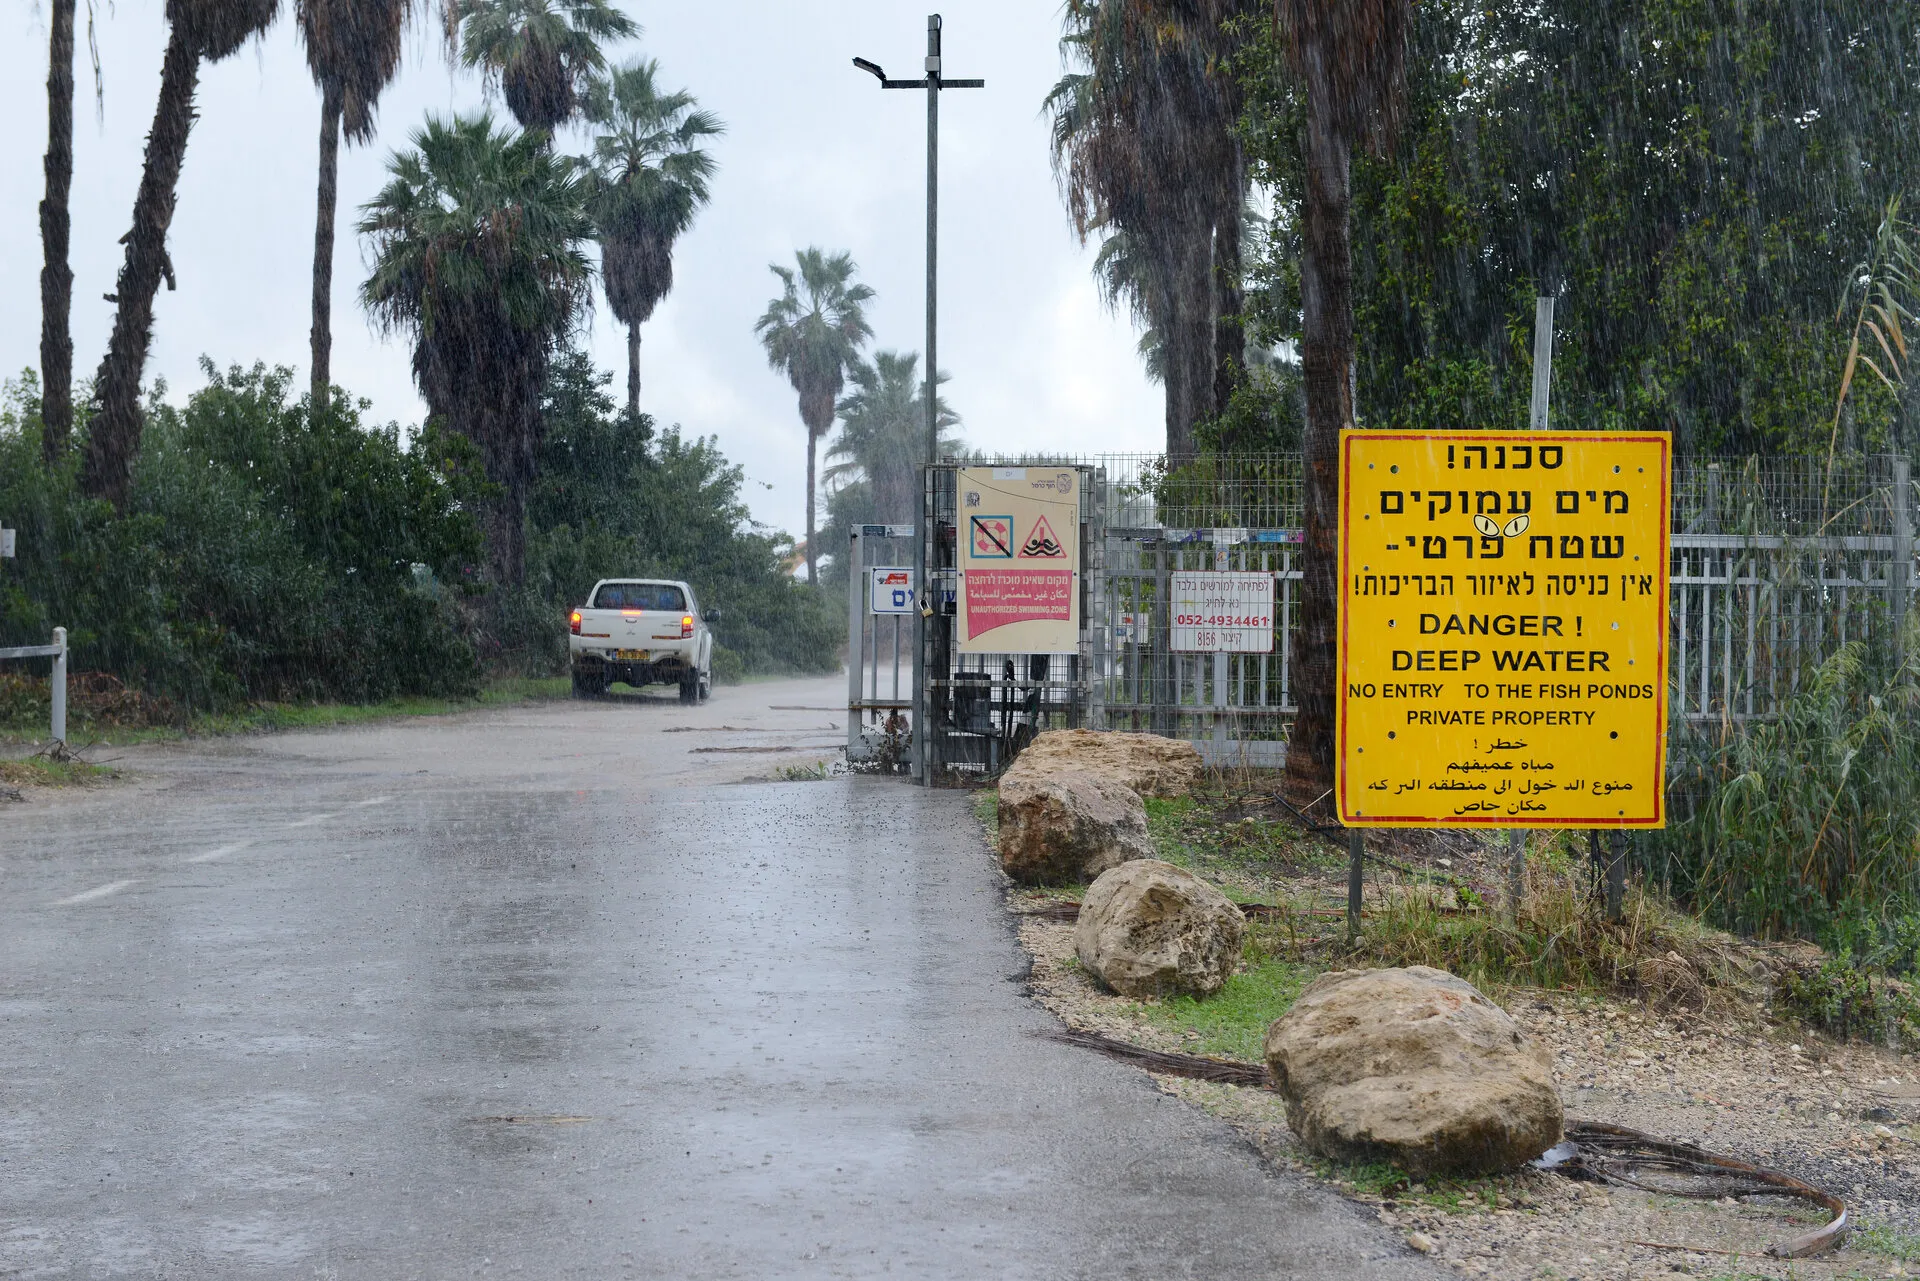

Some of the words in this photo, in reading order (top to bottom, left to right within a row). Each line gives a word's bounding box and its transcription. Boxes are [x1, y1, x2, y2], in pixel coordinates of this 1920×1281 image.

[1447, 444, 1564, 470] סכנה!
[1379, 490, 1532, 521] עמוקים
[1555, 489, 1629, 514] מים
[1528, 535, 1625, 559] שטח
[968, 573, 996, 585] לרחצה
[997, 575, 1021, 585] מוכרז
[1022, 575, 1045, 585] שאינו
[1047, 575, 1068, 587] מקום
[1176, 579, 1197, 591] בלבד
[1237, 579, 1269, 592] לפתיחה
[1354, 573, 1455, 597] הבריכות!
[1465, 570, 1535, 596] לאיזור
[1547, 574, 1609, 596] כניסה
[1033, 590, 1048, 600] غير
[1049, 589, 1068, 600] مكان
[1621, 574, 1653, 602] אין
[970, 605, 1018, 614] UNAUTHORIZED
[1018, 605, 1050, 614] SWIMMING
[1050, 605, 1068, 614] ZONE
[1177, 614, 1268, 627] 052-4934461
[1419, 613, 1564, 637] DANGER
[1576, 615, 1583, 637] !
[1197, 631, 1216, 647] 8156
[1392, 649, 1481, 672] DEEP
[1491, 650, 1611, 672] WATER
[1349, 683, 1377, 699] NO
[1382, 683, 1444, 698] ENTRY
[1463, 683, 1490, 699] TO
[1495, 683, 1533, 699] THE
[1539, 683, 1581, 699] FISH
[1587, 684, 1654, 700] PONDS
[1407, 710, 1486, 725] PRIVATE
[1492, 710, 1596, 726] PROPERTY
[1485, 738, 1528, 754] خطر
[1591, 780, 1633, 796] منوع
[1506, 799, 1547, 816] مكان
